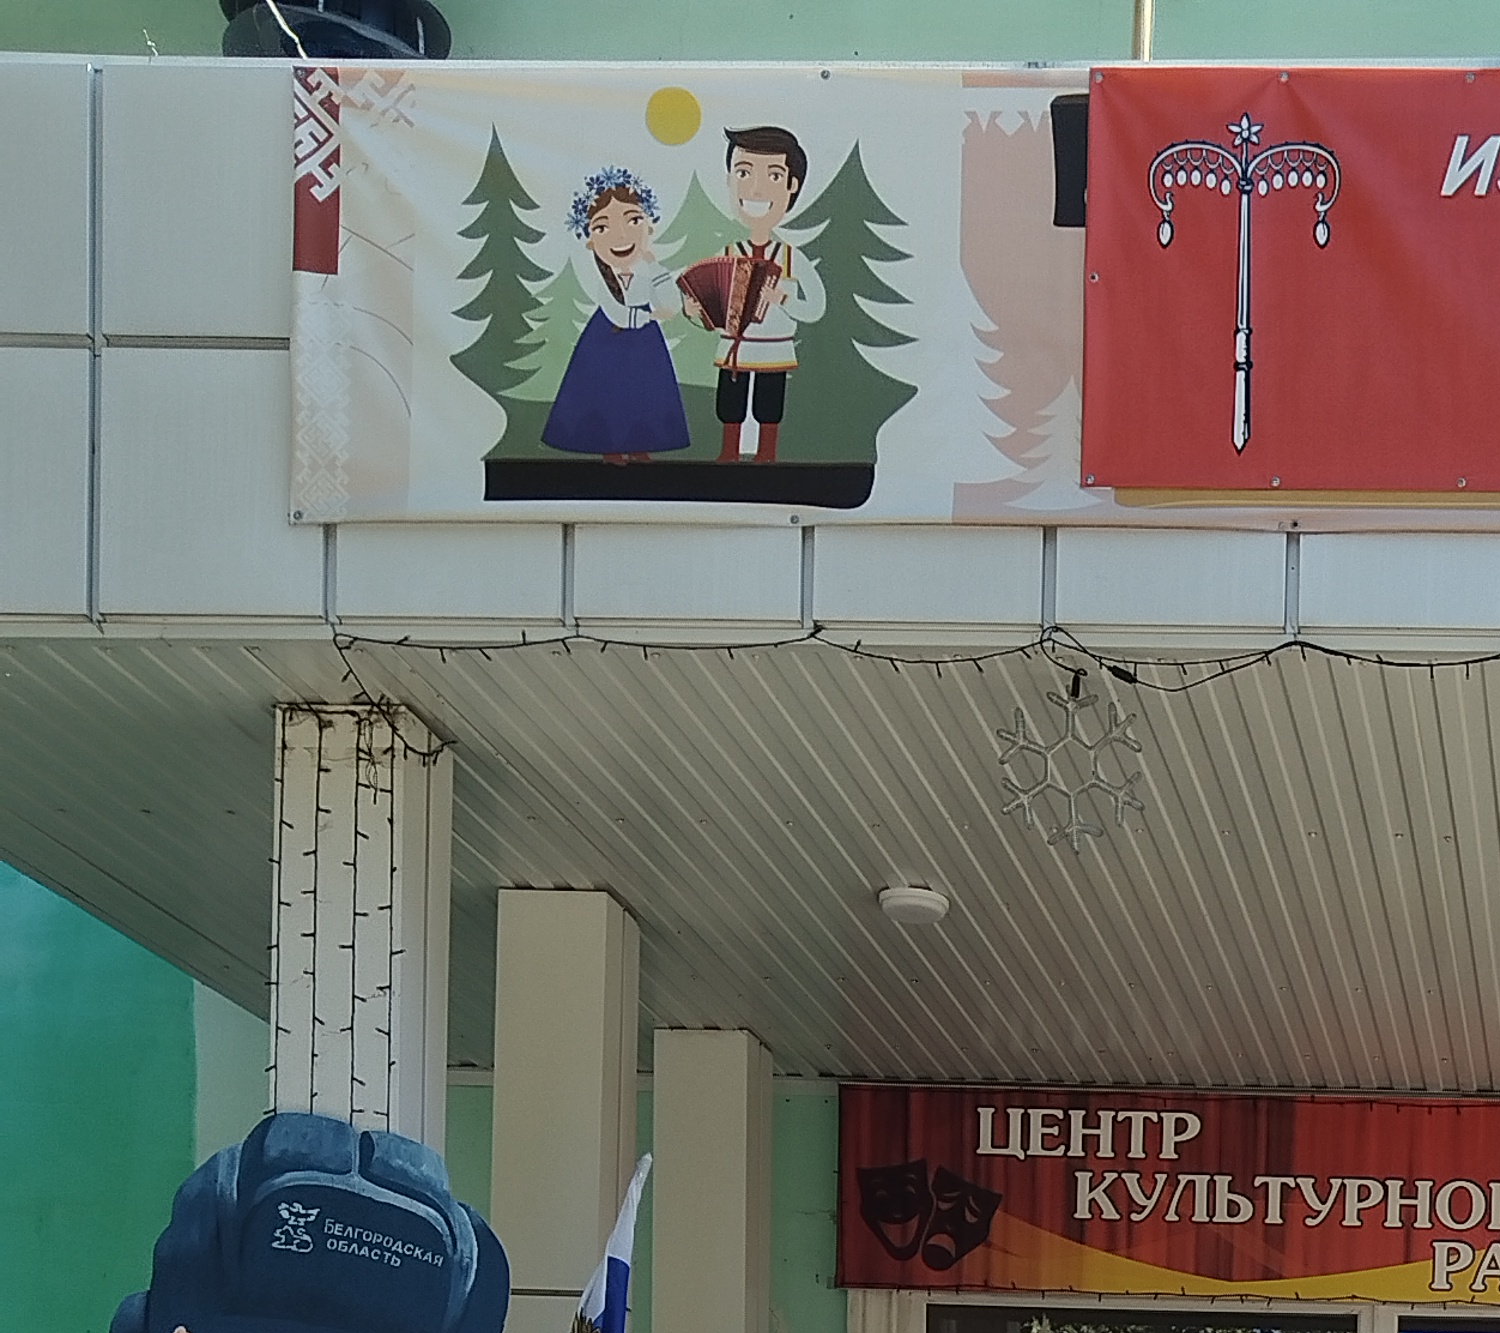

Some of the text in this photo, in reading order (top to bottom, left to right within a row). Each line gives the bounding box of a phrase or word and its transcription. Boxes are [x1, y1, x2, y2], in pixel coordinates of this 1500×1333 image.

[976, 1107, 1201, 1160] ЦЕНТР
[324, 1218, 444, 1267] БЕЛГОРОДСКАЯ
[327, 1238, 401, 1267] ОБЛАСТЬ
